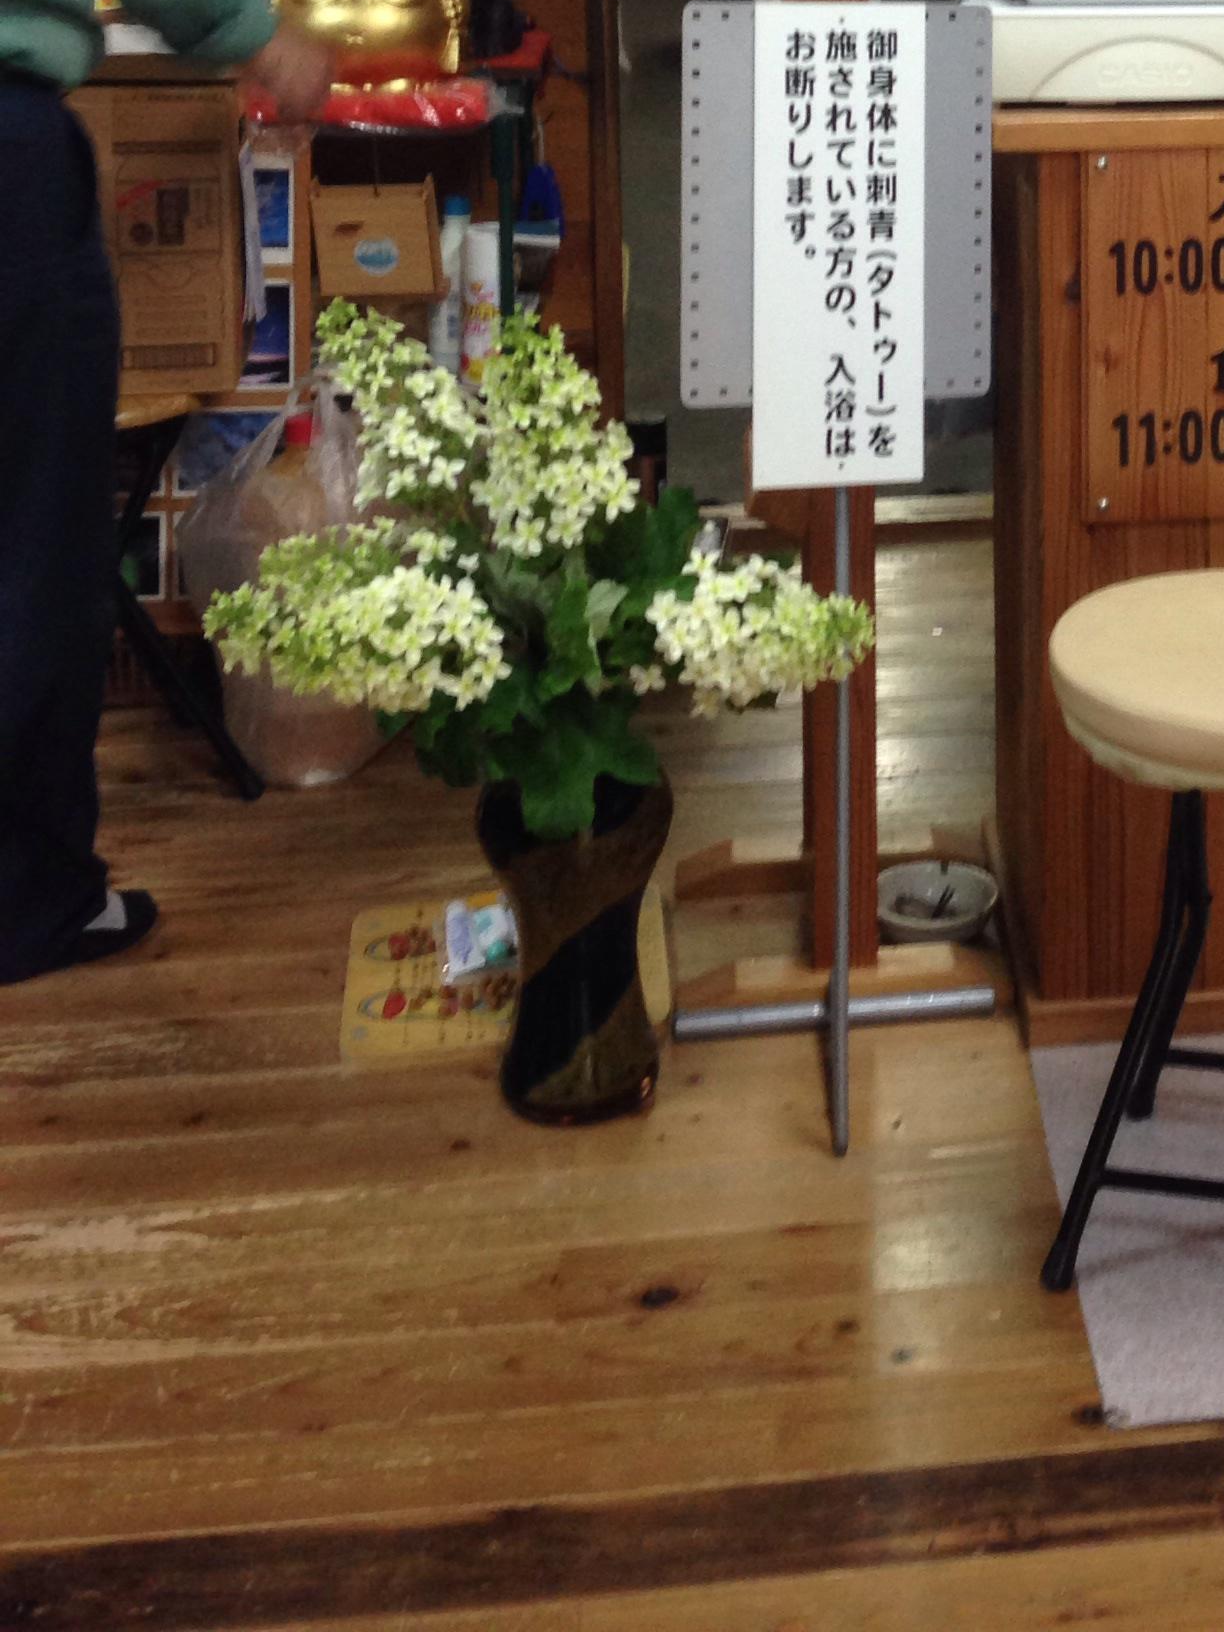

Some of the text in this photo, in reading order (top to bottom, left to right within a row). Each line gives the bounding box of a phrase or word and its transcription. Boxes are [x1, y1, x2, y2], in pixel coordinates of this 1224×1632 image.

[784, 30, 817, 260] お断りします。
[825, 353, 856, 458] 入浴は
